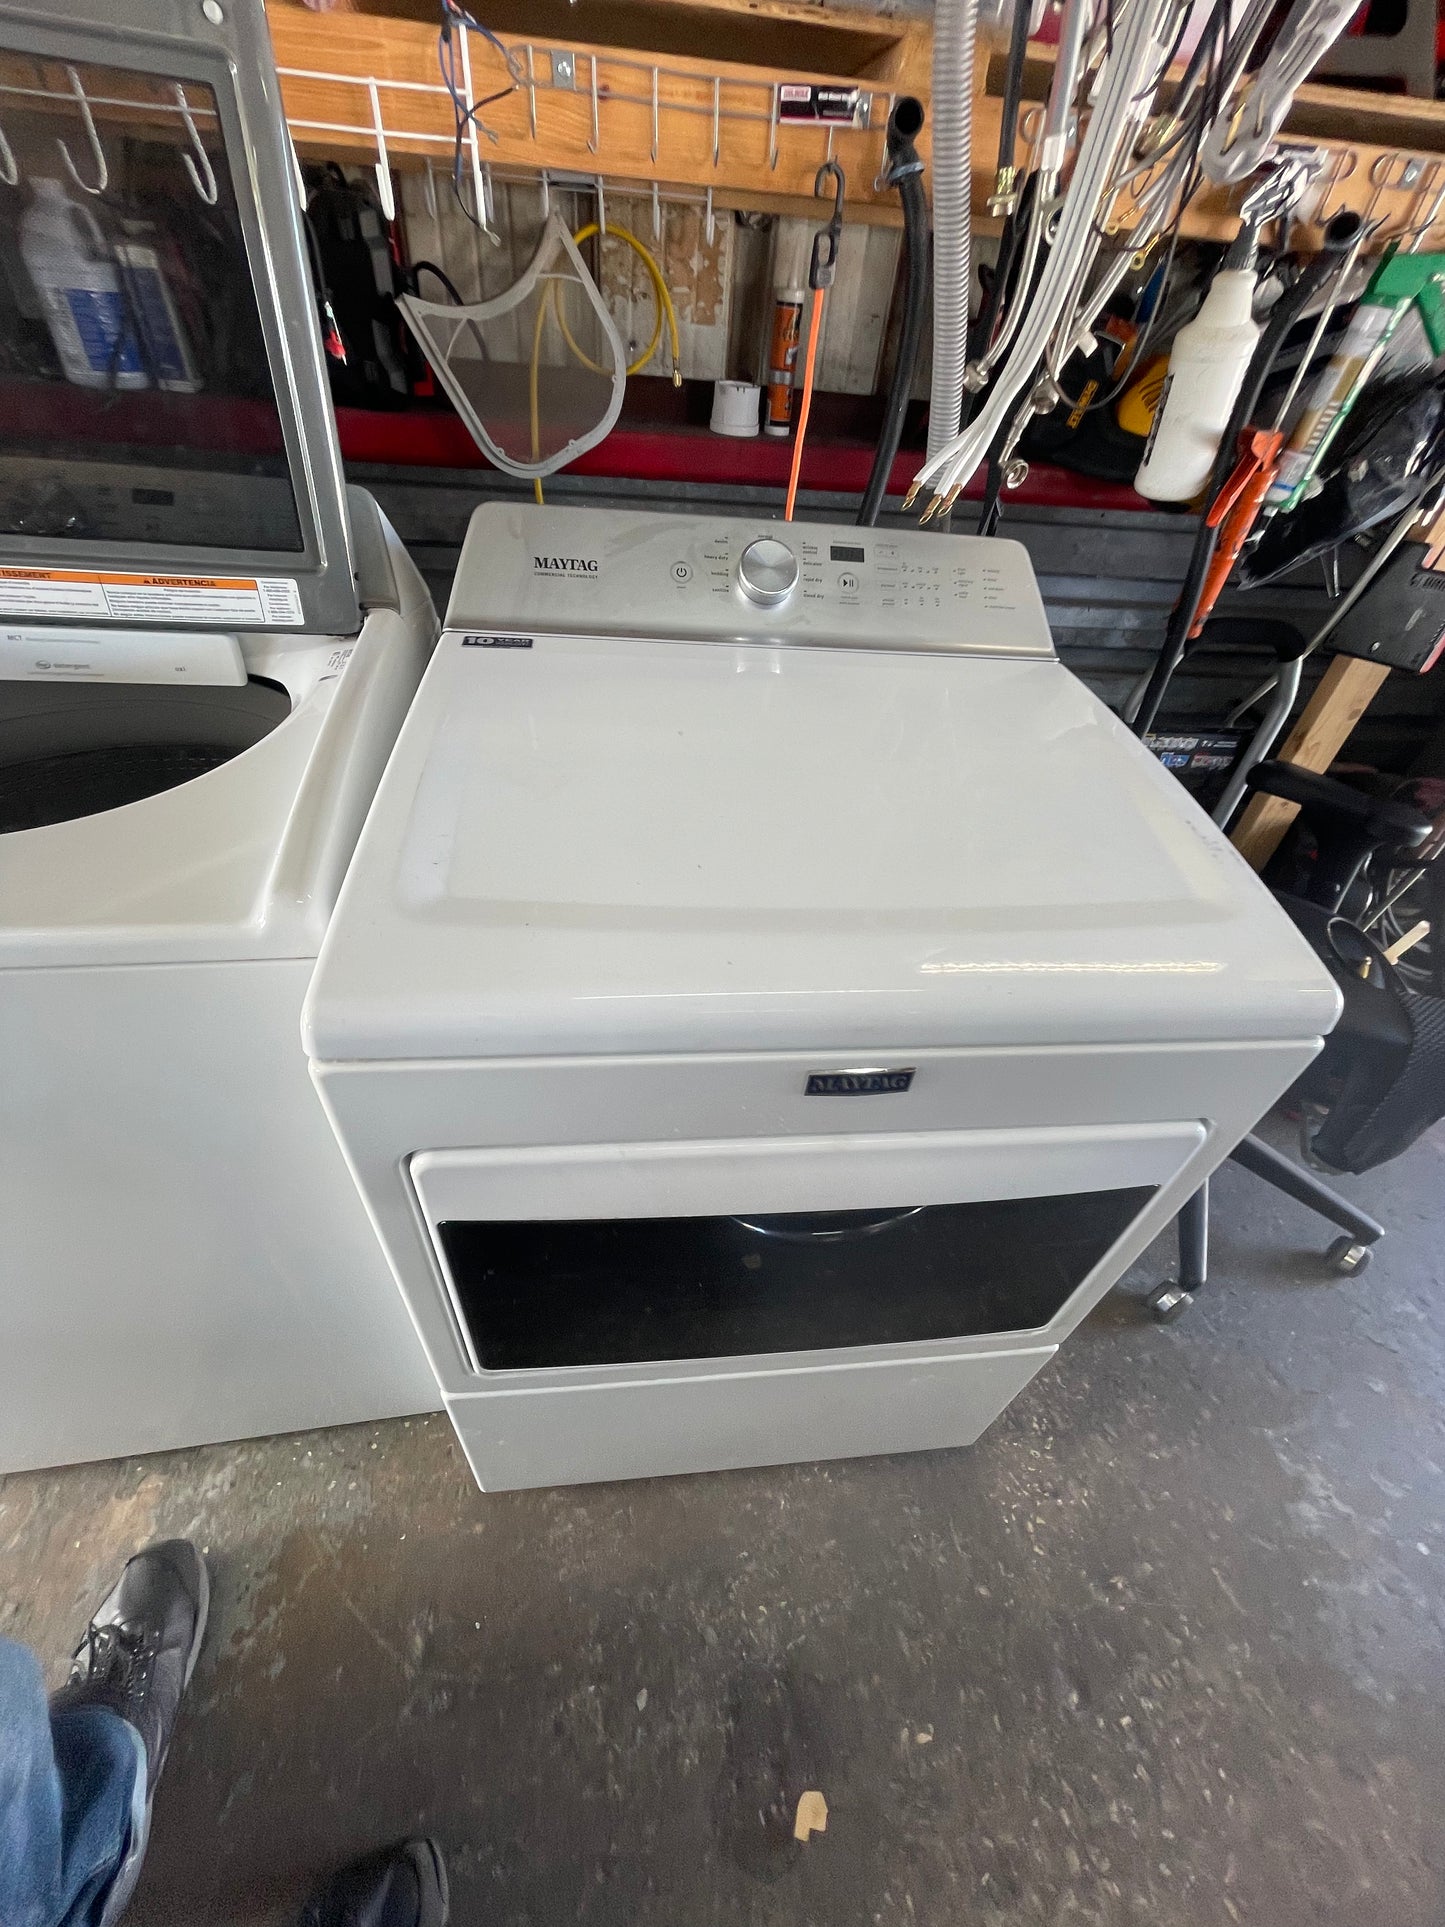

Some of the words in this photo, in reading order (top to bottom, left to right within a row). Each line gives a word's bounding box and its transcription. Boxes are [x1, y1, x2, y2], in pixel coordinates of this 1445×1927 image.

[533, 556, 599, 572] MAYTAG
[0, 570, 52, 579] ISSEMENT
[151, 578, 217, 587] ADVERTENCIA
[467, 636, 495, 645] 10
